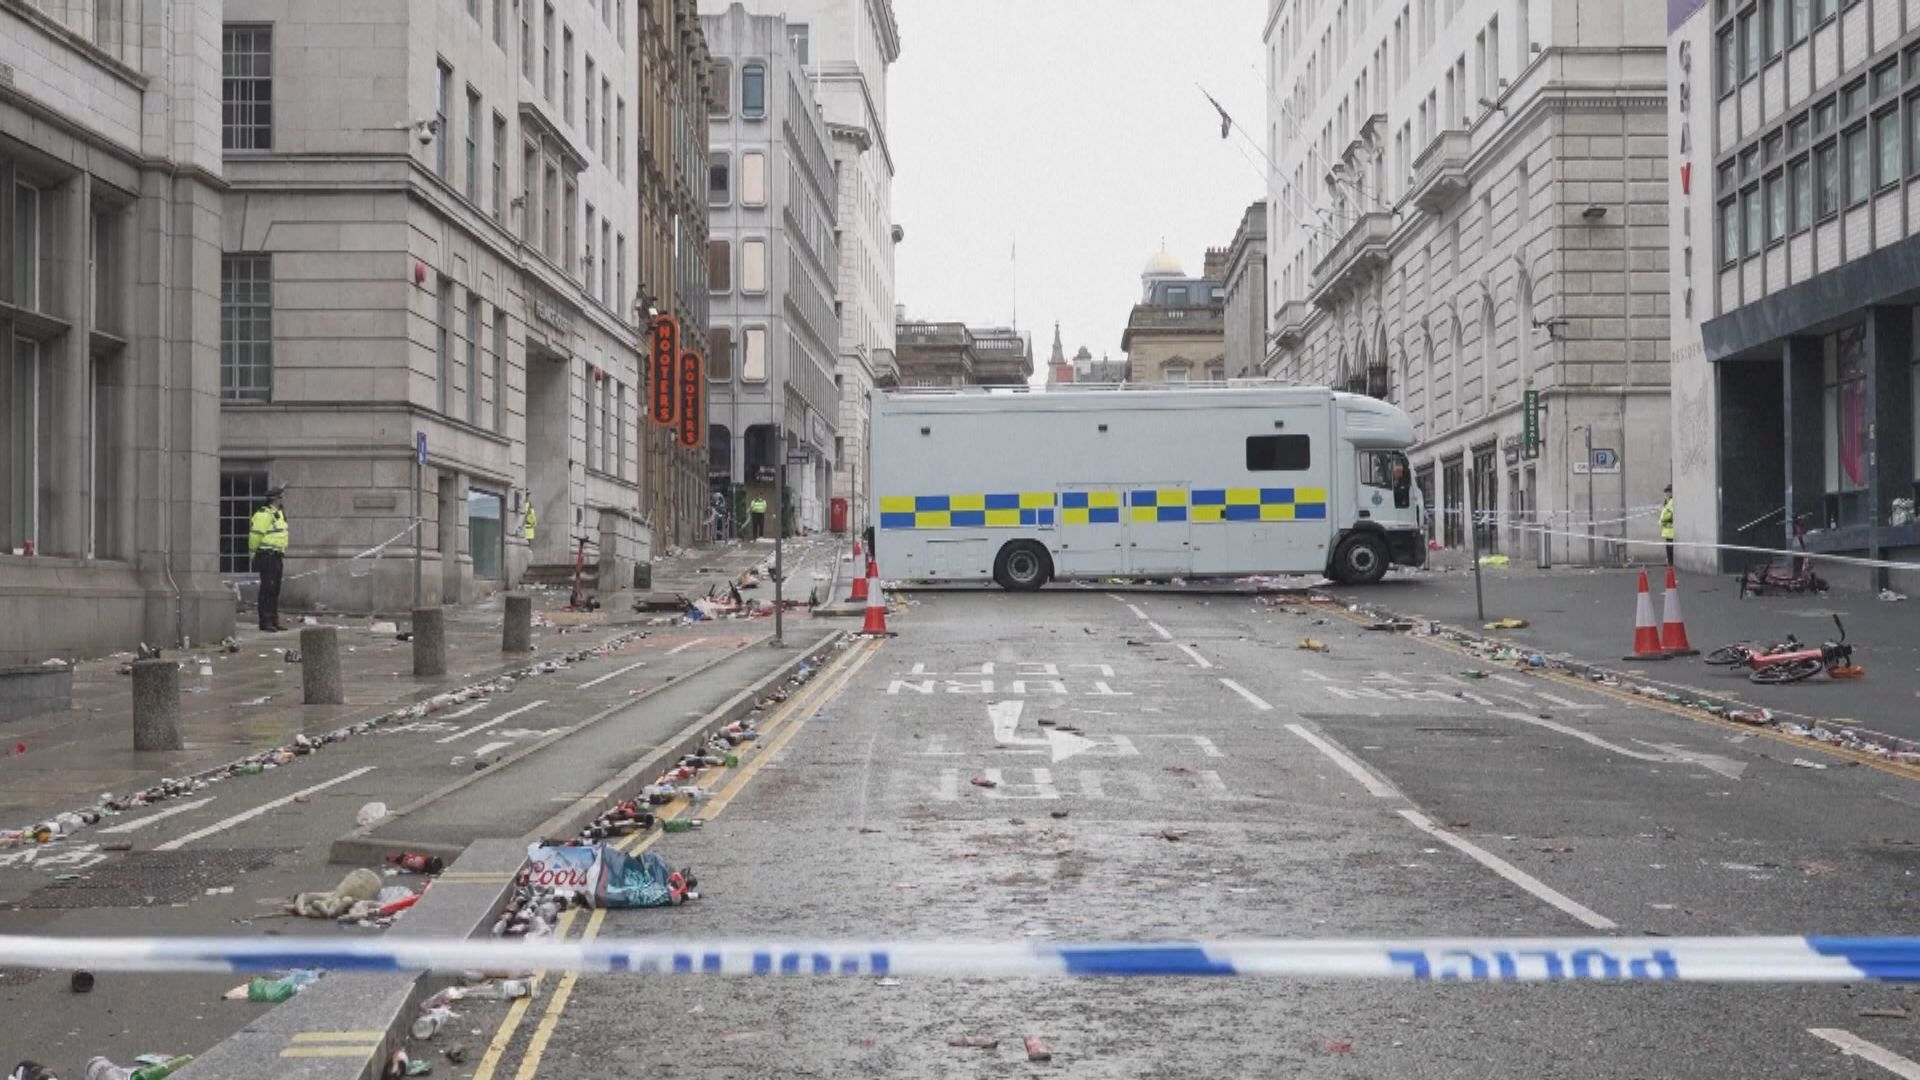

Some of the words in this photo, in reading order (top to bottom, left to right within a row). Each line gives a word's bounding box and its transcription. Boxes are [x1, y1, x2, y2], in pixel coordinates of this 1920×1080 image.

[1678, 39, 1694, 319] GRAVITY
[660, 325, 671, 419] HOOTERS
[685, 360, 695, 442] HOOTERS
[885, 679, 1134, 696] TURN
[516, 860, 589, 887] Coors
